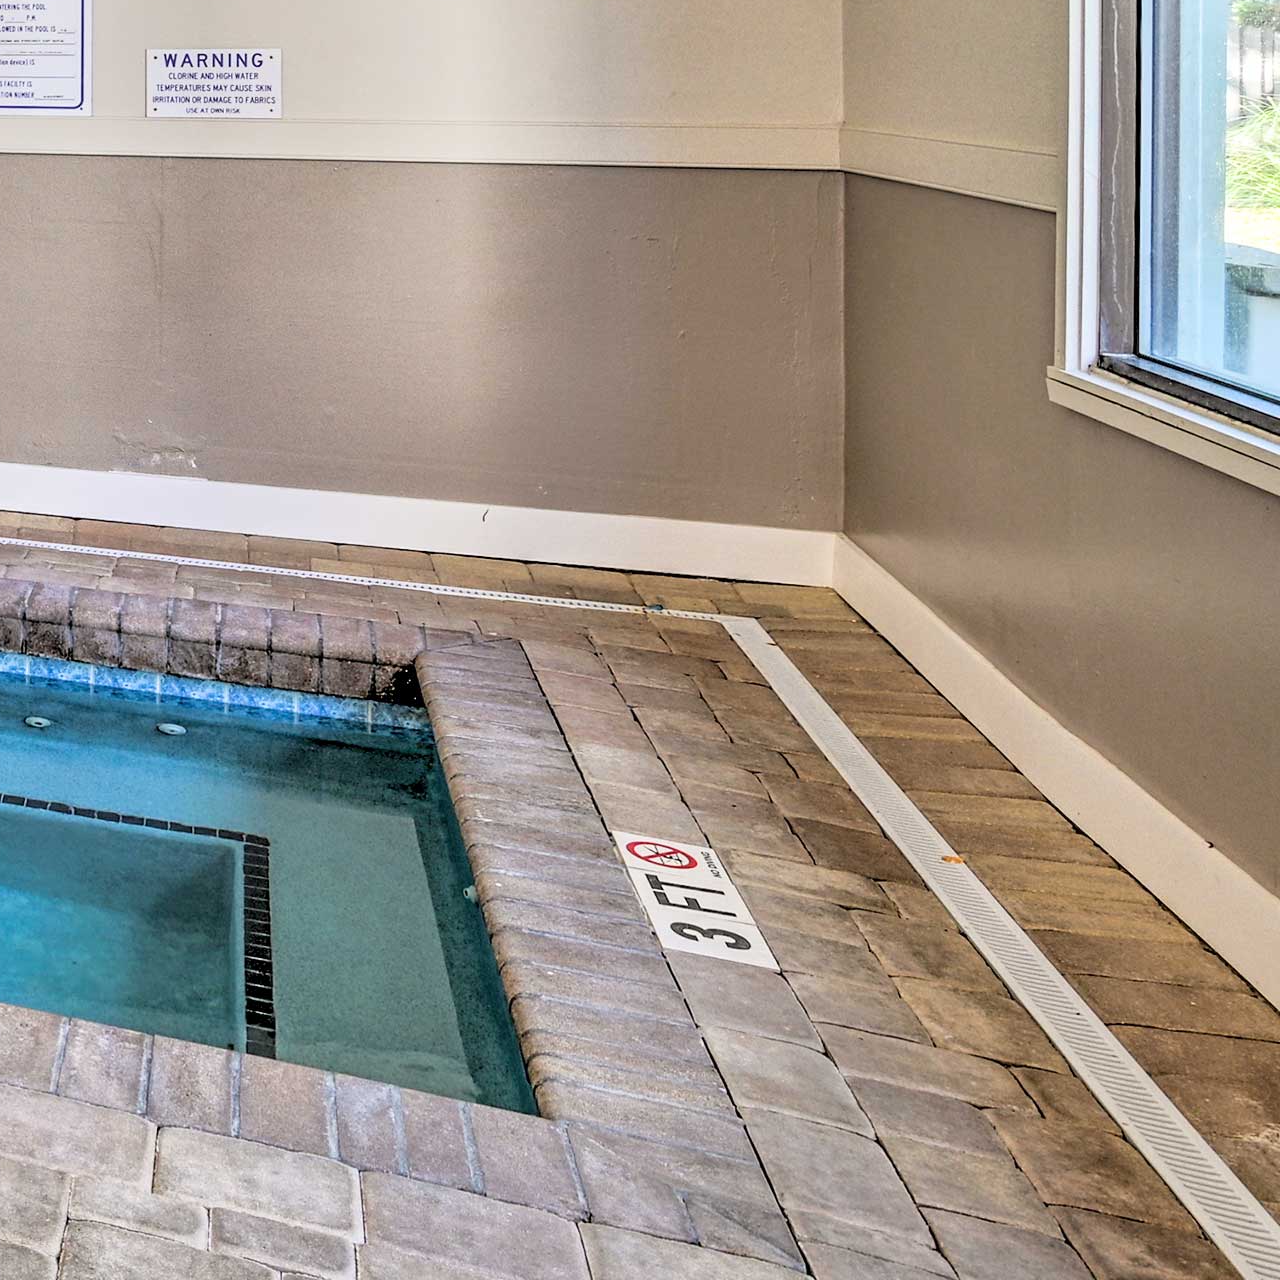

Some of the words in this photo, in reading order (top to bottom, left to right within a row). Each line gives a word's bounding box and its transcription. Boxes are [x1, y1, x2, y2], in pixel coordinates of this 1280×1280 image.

[164, 53, 263, 67] WARNING
[645, 874, 737, 917] FT
[670, 922, 751, 950] 3
